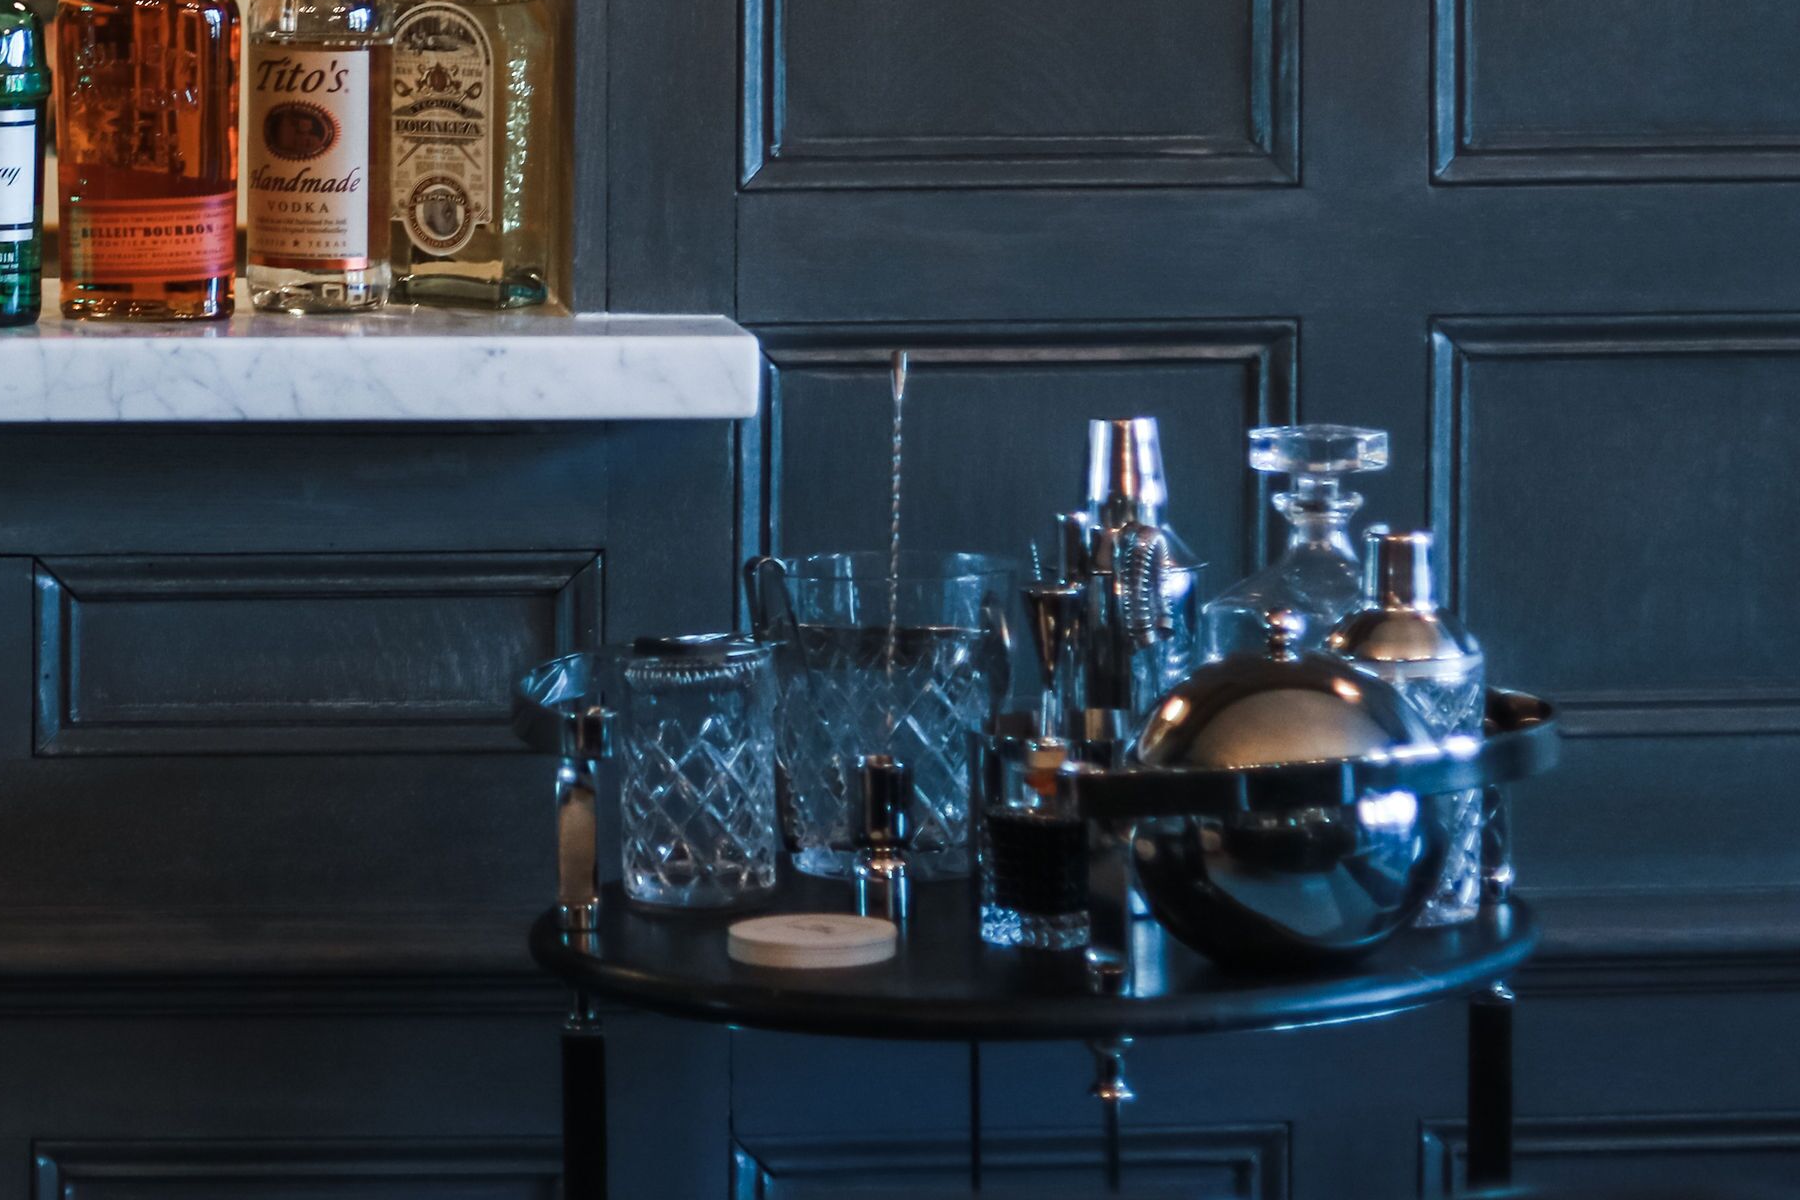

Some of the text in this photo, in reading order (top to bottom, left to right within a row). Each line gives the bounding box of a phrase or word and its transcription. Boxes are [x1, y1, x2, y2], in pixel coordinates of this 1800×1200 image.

[256, 56, 349, 93] Tito's
[249, 164, 361, 193] Handmade
[266, 202, 329, 214] VODKA
[81, 224, 214, 238] BULLEIT BOURBON
